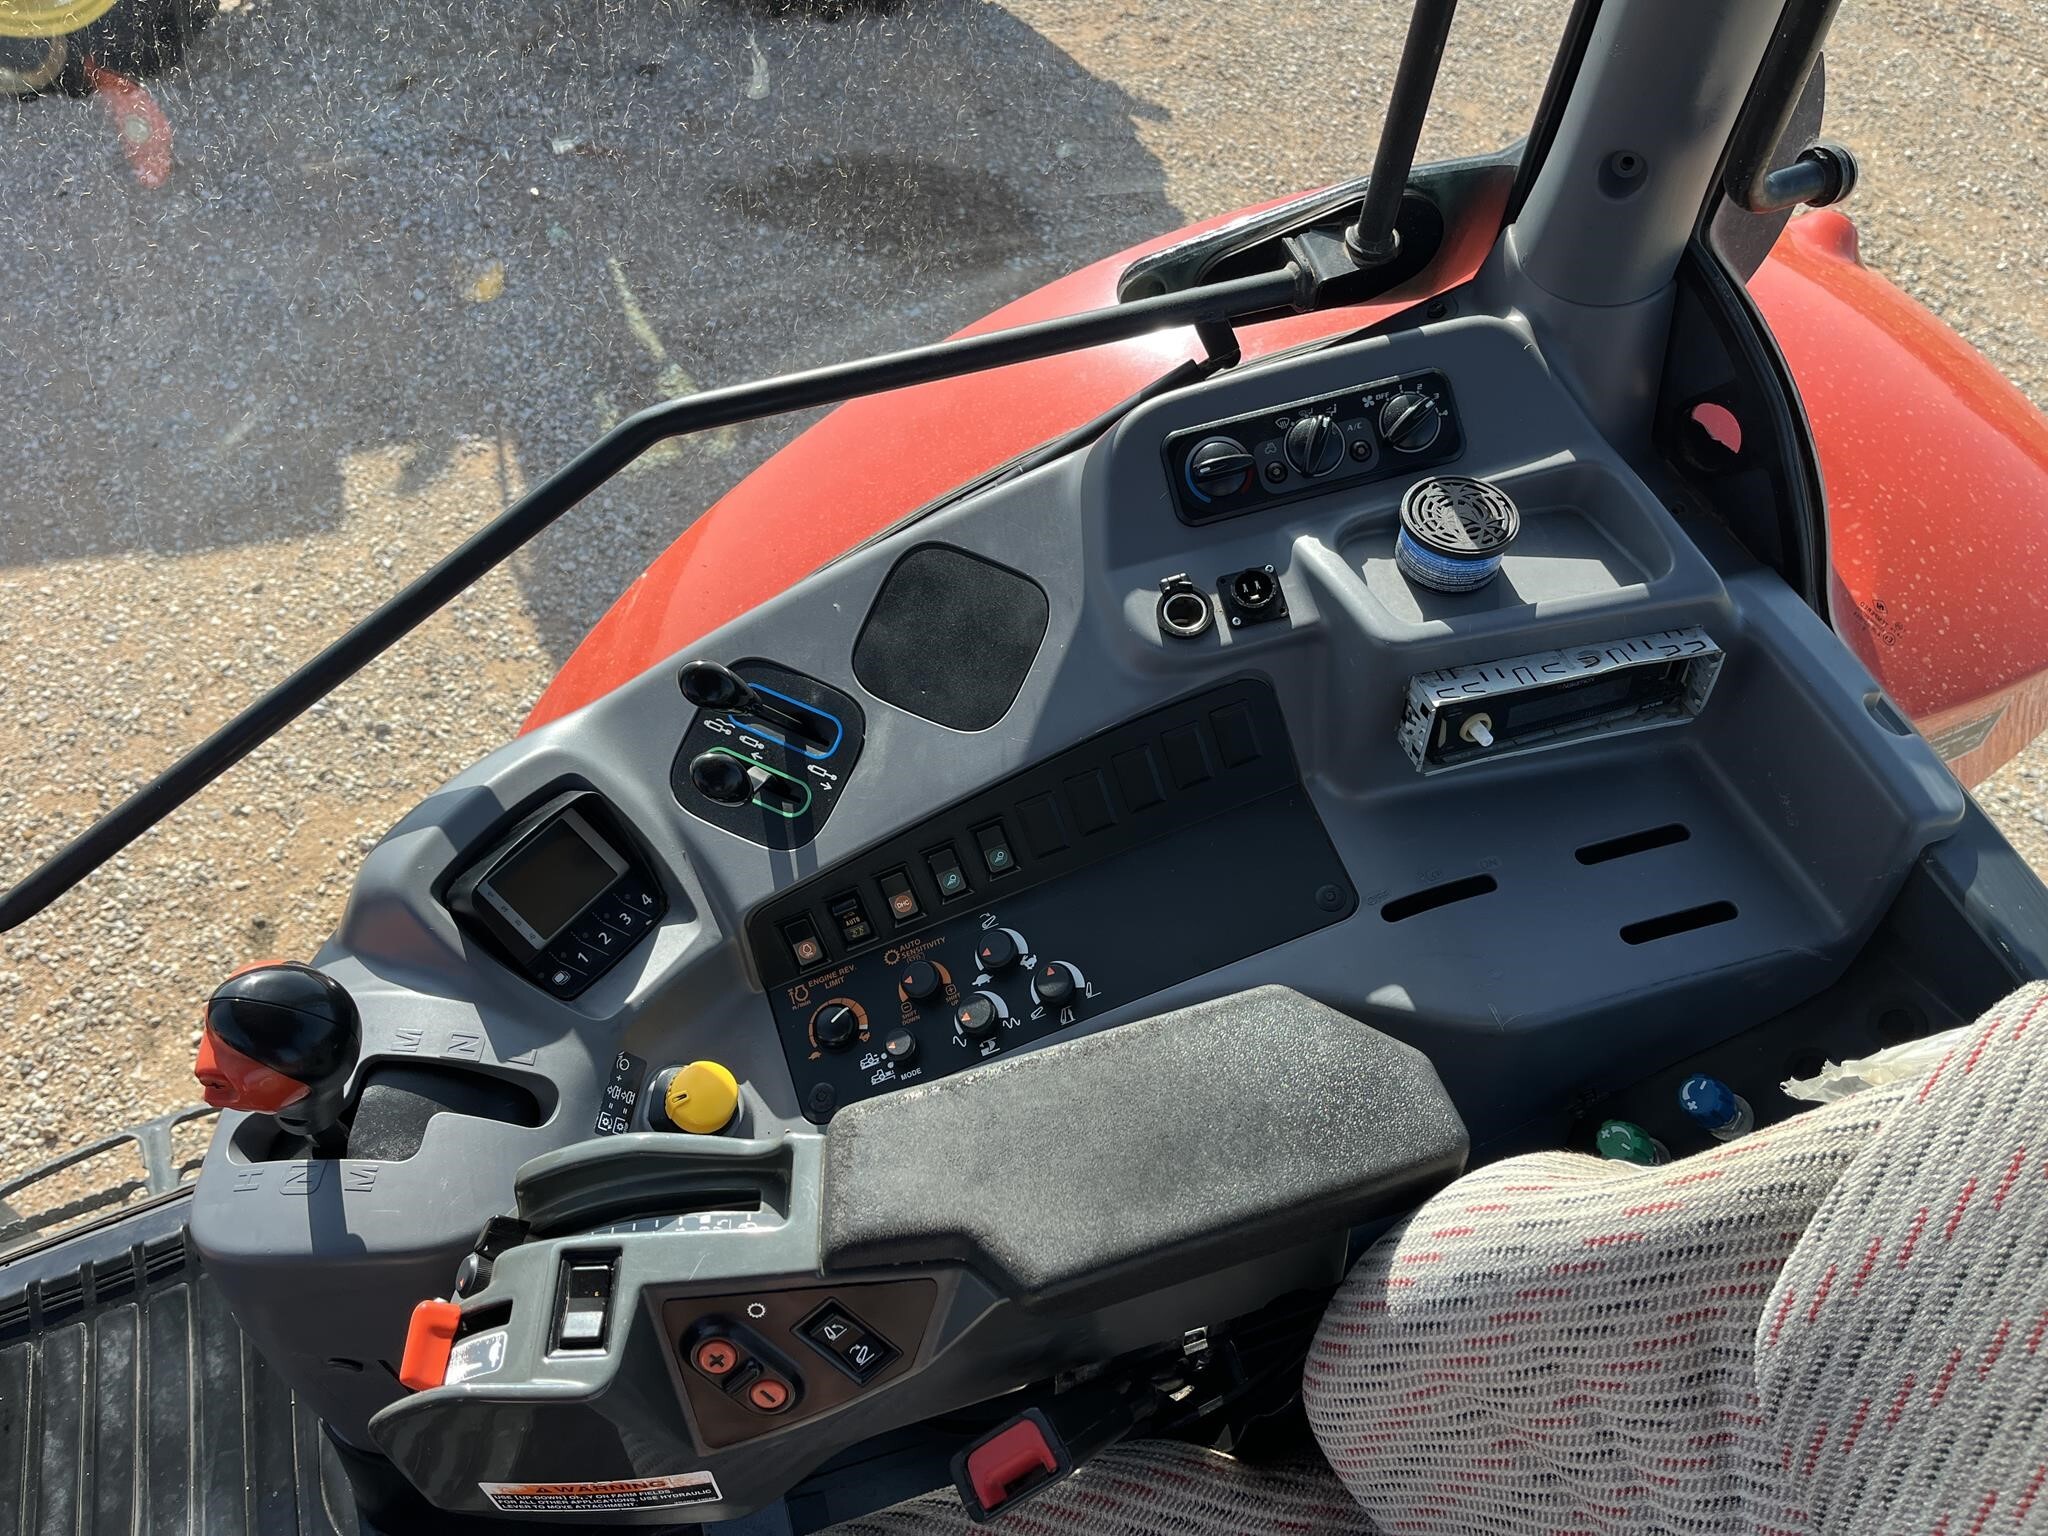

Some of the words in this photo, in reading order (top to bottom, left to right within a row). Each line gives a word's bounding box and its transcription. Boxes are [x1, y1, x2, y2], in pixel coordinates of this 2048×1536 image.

[1375, 391, 1390, 401] OFF
[1433, 392, 1440, 400] 3
[1347, 422, 1363, 431] A/C
[641, 893, 653, 905] 4
[896, 899, 910, 909] DHC
[618, 912, 632, 925] 3
[846, 916, 861, 927] AUTO
[598, 931, 612, 945] 2
[900, 938, 921, 951] AUTO
[901, 936, 946, 959] SENSITIVITY
[577, 952, 589, 963] 1
[808, 970, 838, 987] ENGINE
[838, 963, 857, 976] REV.
[824, 976, 845, 990] LIMIT
[945, 992, 960, 1002] SHIFT
[902, 1009, 917, 1020] SHIFT
[902, 1015, 920, 1025] DOWN
[391, 1028, 424, 1052] M
[447, 1032, 481, 1054] N
[901, 1067, 922, 1081] MODE
[233, 1168, 265, 1192] H
[285, 1165, 319, 1190] N
[343, 1164, 379, 1192] M
[553, 1480, 666, 1493] WARNING
[660, 1489, 712, 1500] HYDRAULIC
